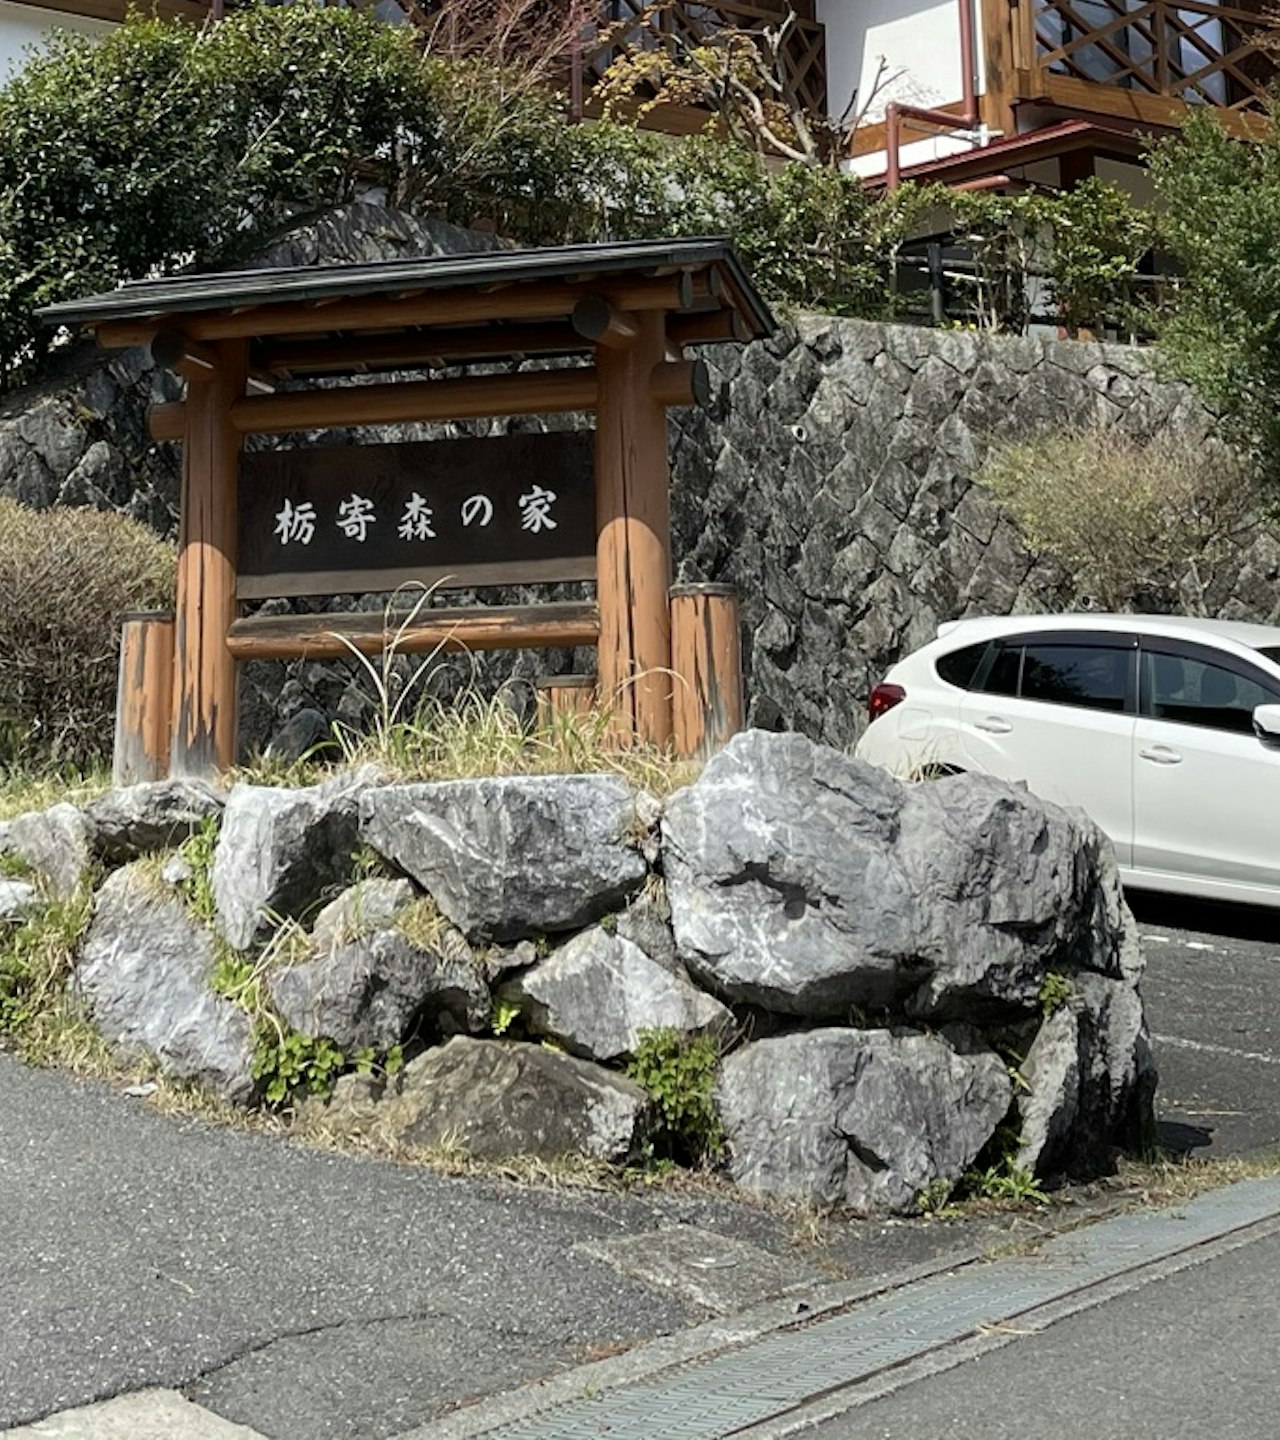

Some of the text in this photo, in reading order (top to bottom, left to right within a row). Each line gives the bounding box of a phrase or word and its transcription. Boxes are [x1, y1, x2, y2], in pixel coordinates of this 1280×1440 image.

[273, 484, 559, 545] 栃寄森の家
